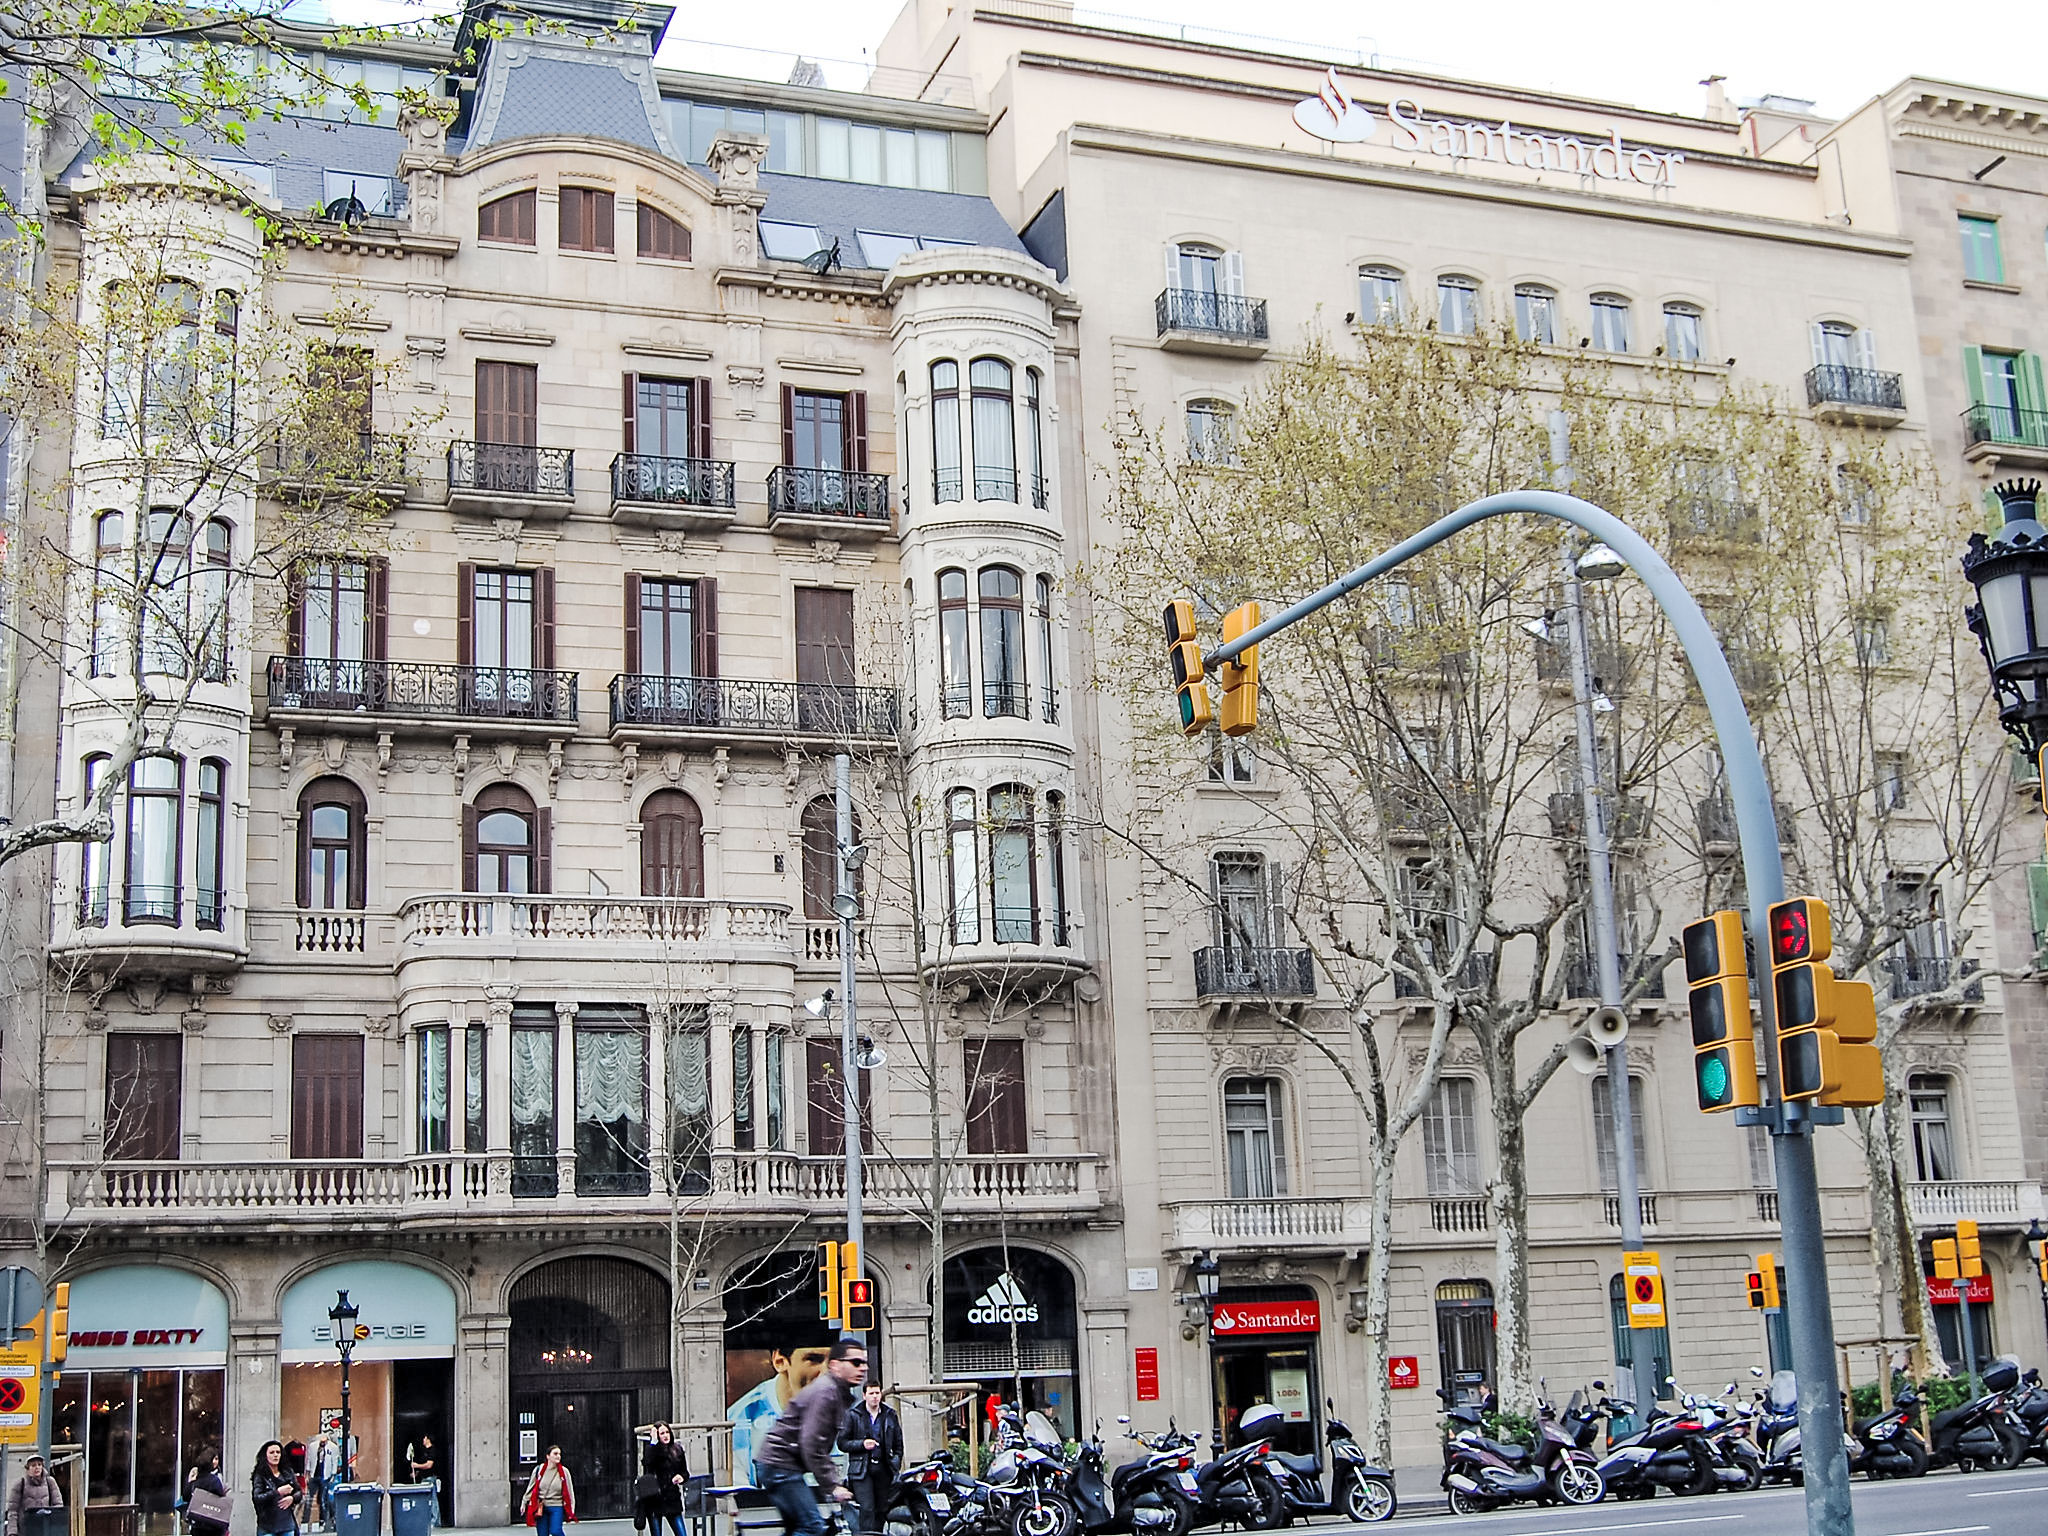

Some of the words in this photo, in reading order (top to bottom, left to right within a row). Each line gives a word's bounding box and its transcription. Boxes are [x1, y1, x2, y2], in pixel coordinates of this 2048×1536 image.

[1387, 97, 1685, 188] Santander
[968, 1304, 1039, 1324] adidas
[1238, 1308, 1317, 1329] Santander
[68, 1330, 129, 1347] MISS
[132, 1328, 204, 1347] SIXTY
[314, 1323, 426, 1341] EERGIE
